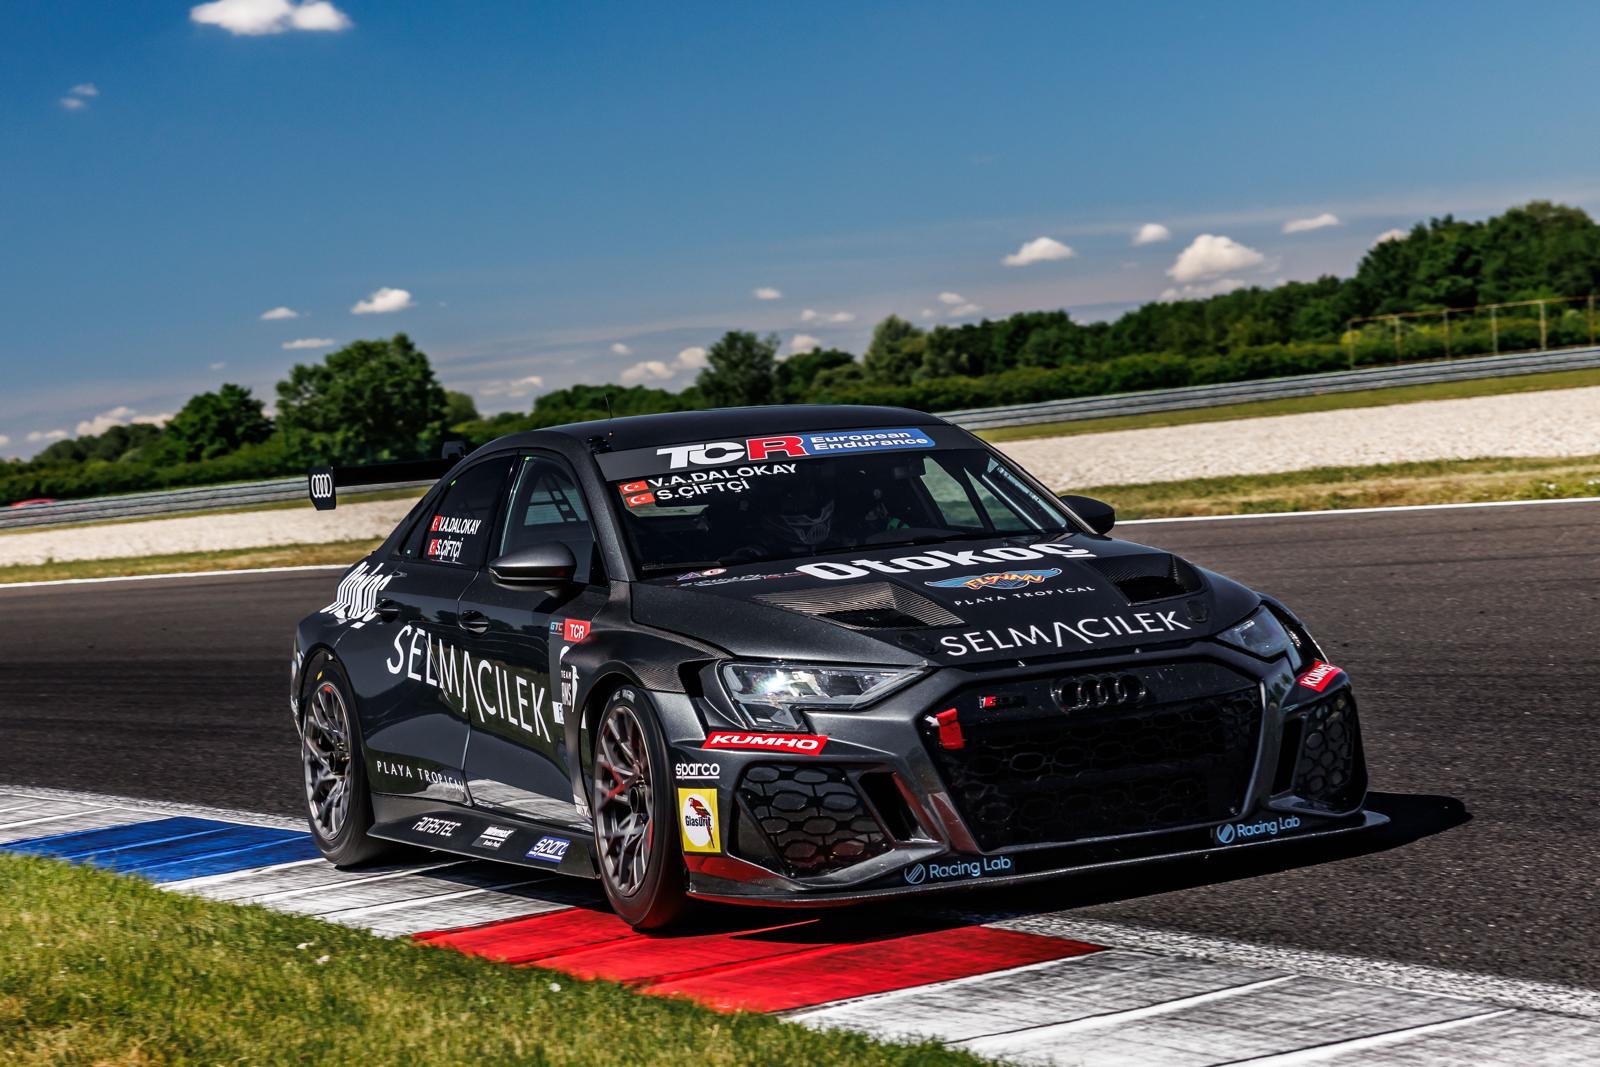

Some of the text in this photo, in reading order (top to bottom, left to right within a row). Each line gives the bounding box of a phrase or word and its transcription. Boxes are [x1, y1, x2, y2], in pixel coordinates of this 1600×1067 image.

[811, 431, 911, 443] European
[813, 438, 929, 450] Endurance
[656, 435, 808, 469] TCR
[648, 463, 797, 488] V.A.DALOKAY
[954, 586, 1096, 606] PLAYA TROPICAL
[570, 624, 585, 639] TCR
[711, 734, 820, 751] KUMHO
[377, 760, 413, 778] PLAYA
[675, 763, 720, 780] sparco
[1236, 816, 1301, 838] Racing Lab
[929, 857, 1012, 882] Racing Lab
